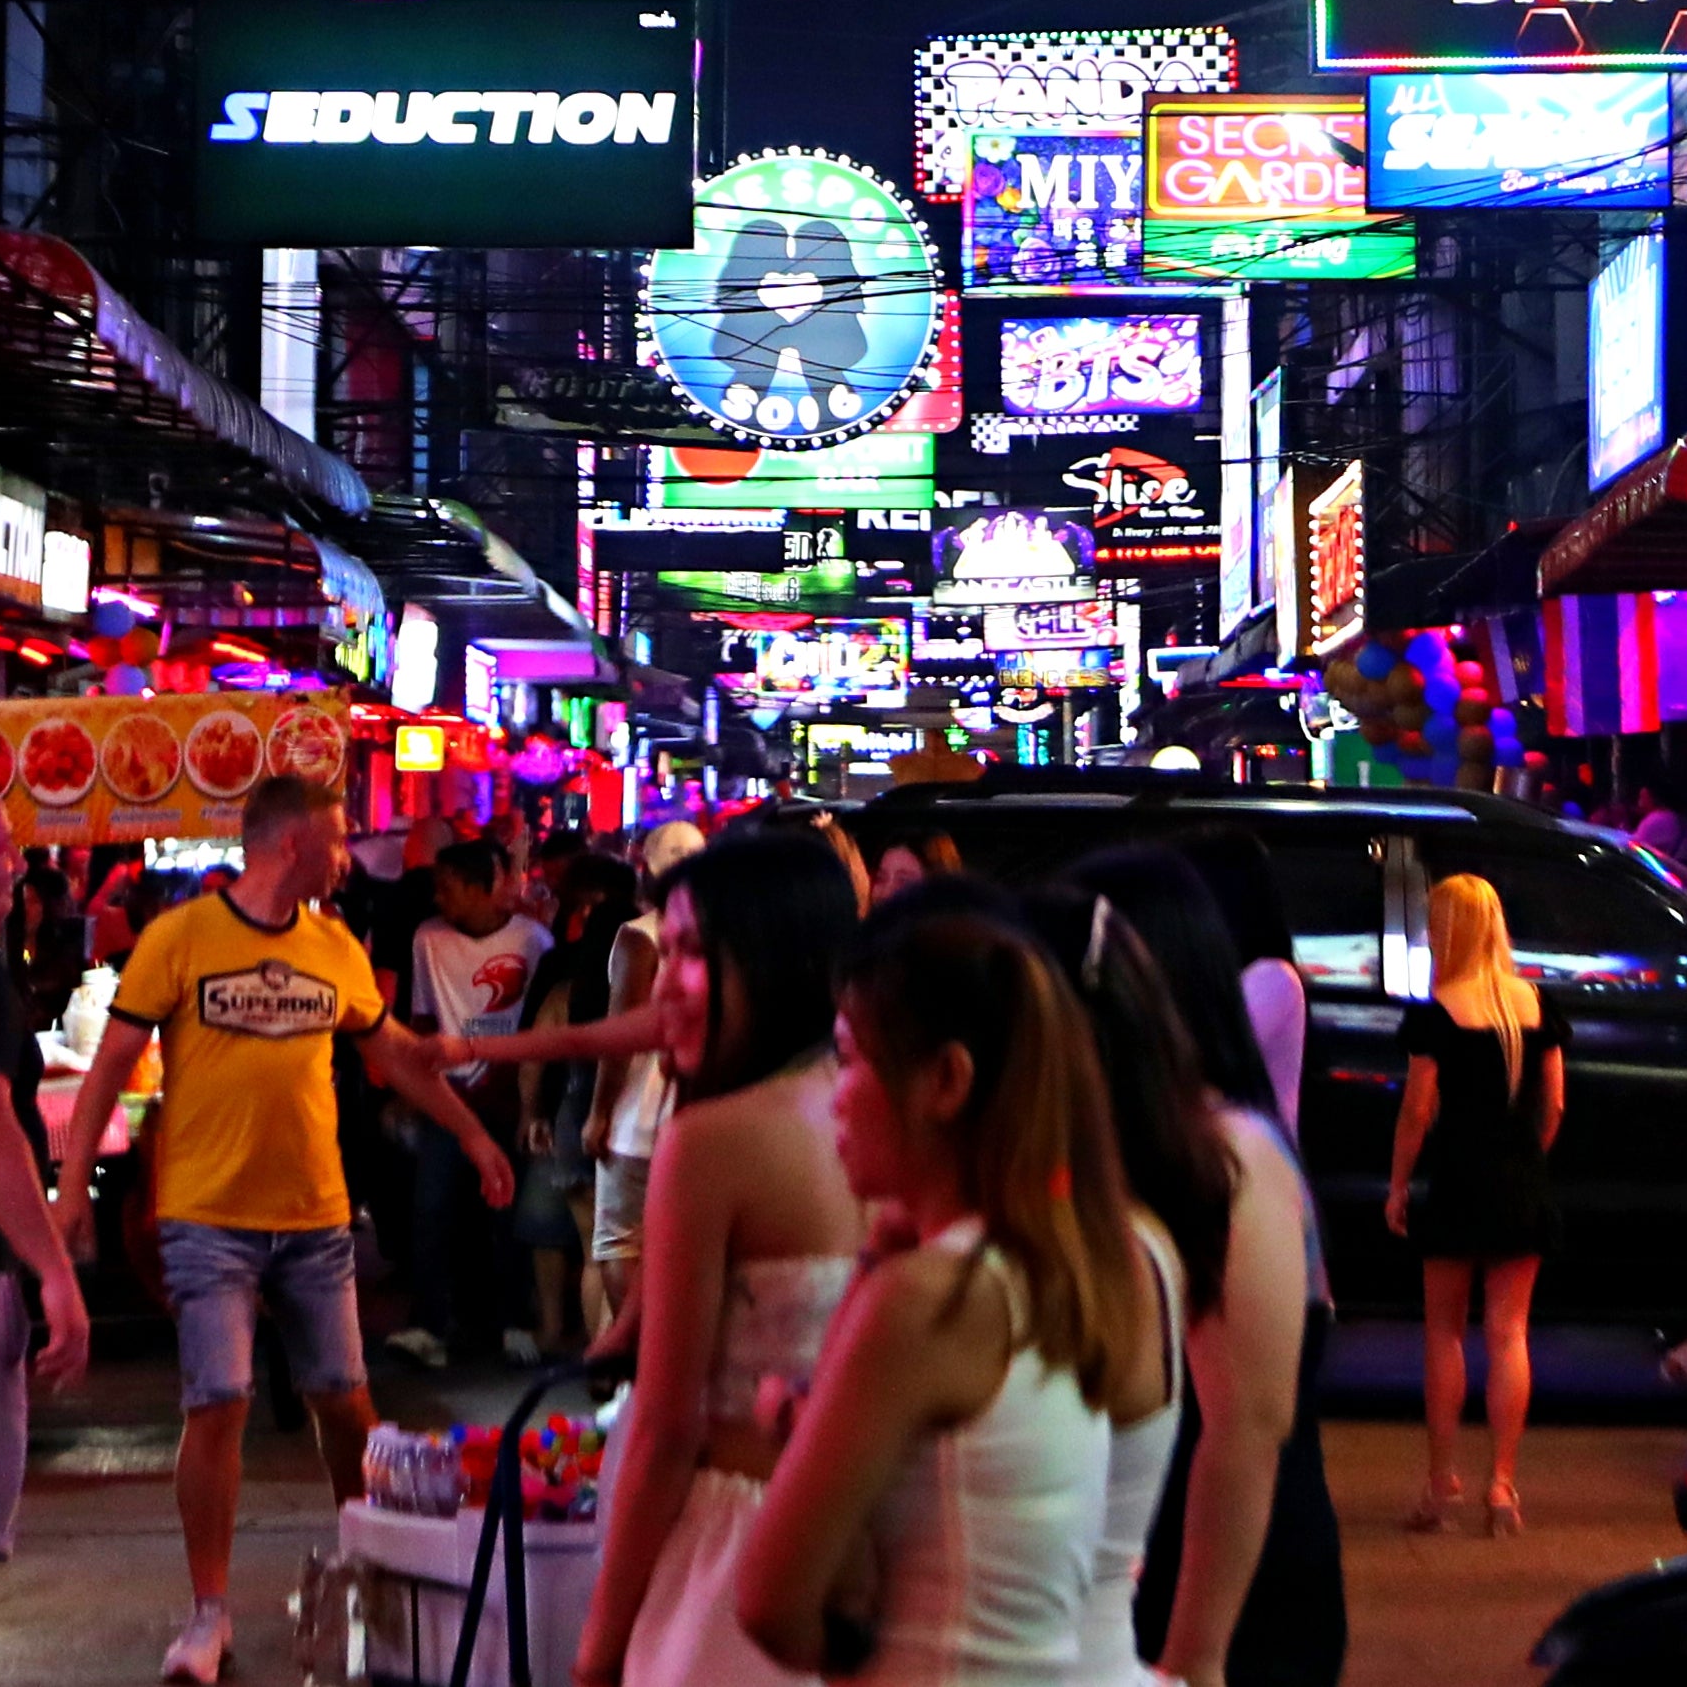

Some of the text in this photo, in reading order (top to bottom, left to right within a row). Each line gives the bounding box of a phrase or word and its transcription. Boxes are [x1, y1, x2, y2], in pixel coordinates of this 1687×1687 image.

[208, 90, 677, 145] SEDUCTION
[944, 59, 1207, 125] PANDA
[1177, 115, 1365, 158] SECRE
[1015, 153, 1143, 209] MIY
[1165, 159, 1365, 205] GARDE
[1033, 343, 1164, 410] BTS
[720, 383, 863, 431] SOI 6
